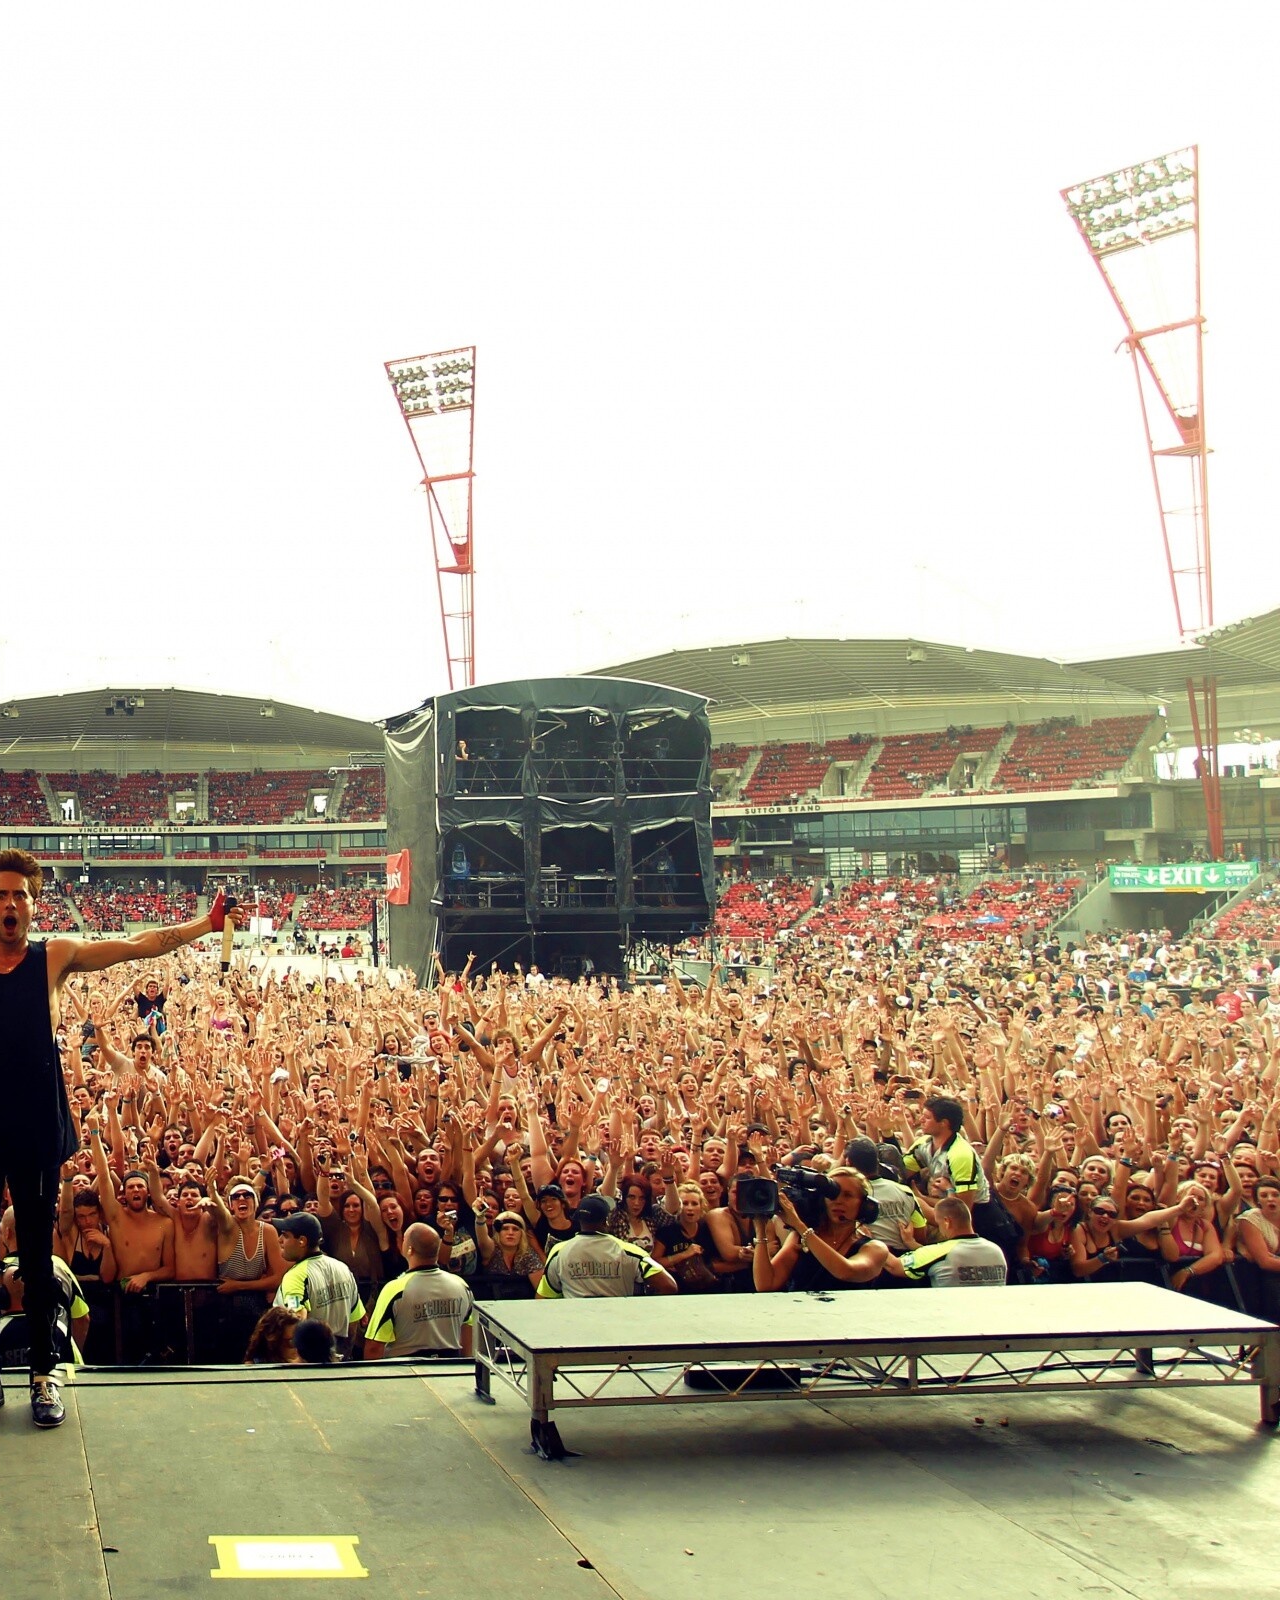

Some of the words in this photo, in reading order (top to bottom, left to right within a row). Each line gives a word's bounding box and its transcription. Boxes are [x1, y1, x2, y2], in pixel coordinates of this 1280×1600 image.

[745, 807, 781, 815] SUTTOR
[788, 805, 821, 813] STAND
[1159, 866, 1205, 885] EXIT
[568, 1261, 621, 1276] SECURITY
[413, 1298, 463, 1319] SECURITY
